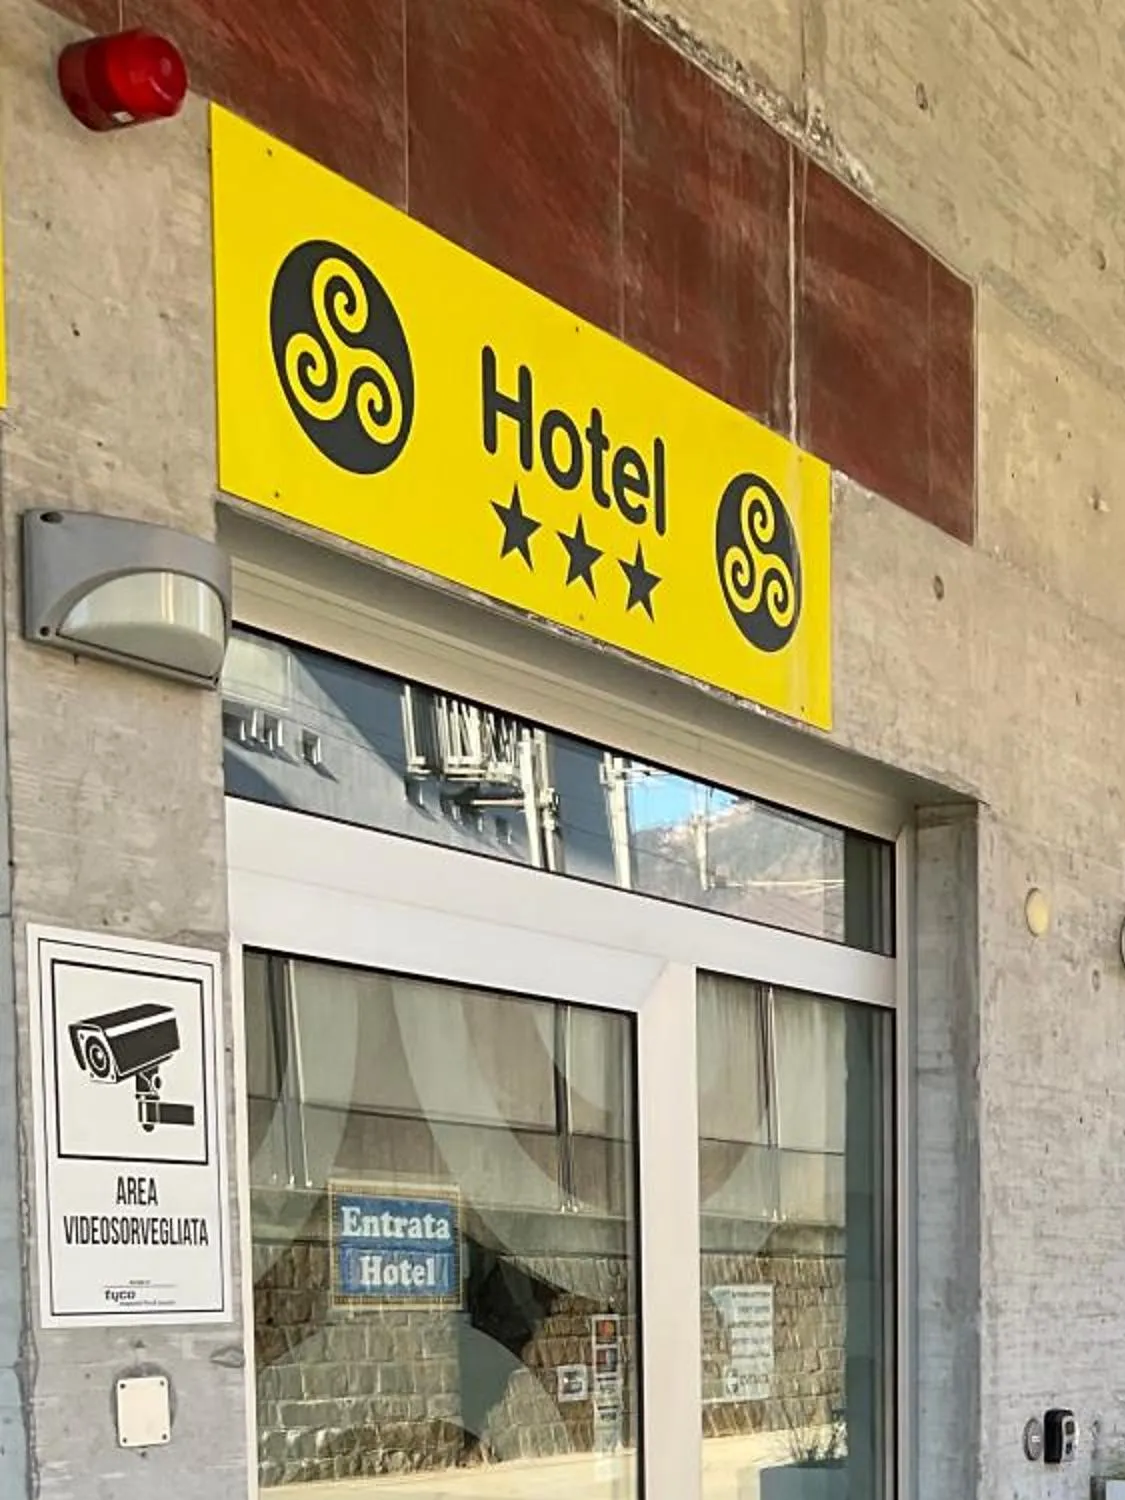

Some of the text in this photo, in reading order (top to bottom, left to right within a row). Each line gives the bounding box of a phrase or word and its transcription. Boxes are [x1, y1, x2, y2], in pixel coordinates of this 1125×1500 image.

[481, 345, 667, 536] Hotel
[115, 1176, 159, 1206] AREA
[63, 1215, 209, 1247] VIDEOSORVEGLIATA
[340, 1206, 452, 1240] Entrata
[358, 1253, 438, 1288] Hotel
[104, 1288, 136, 1303] tyco
